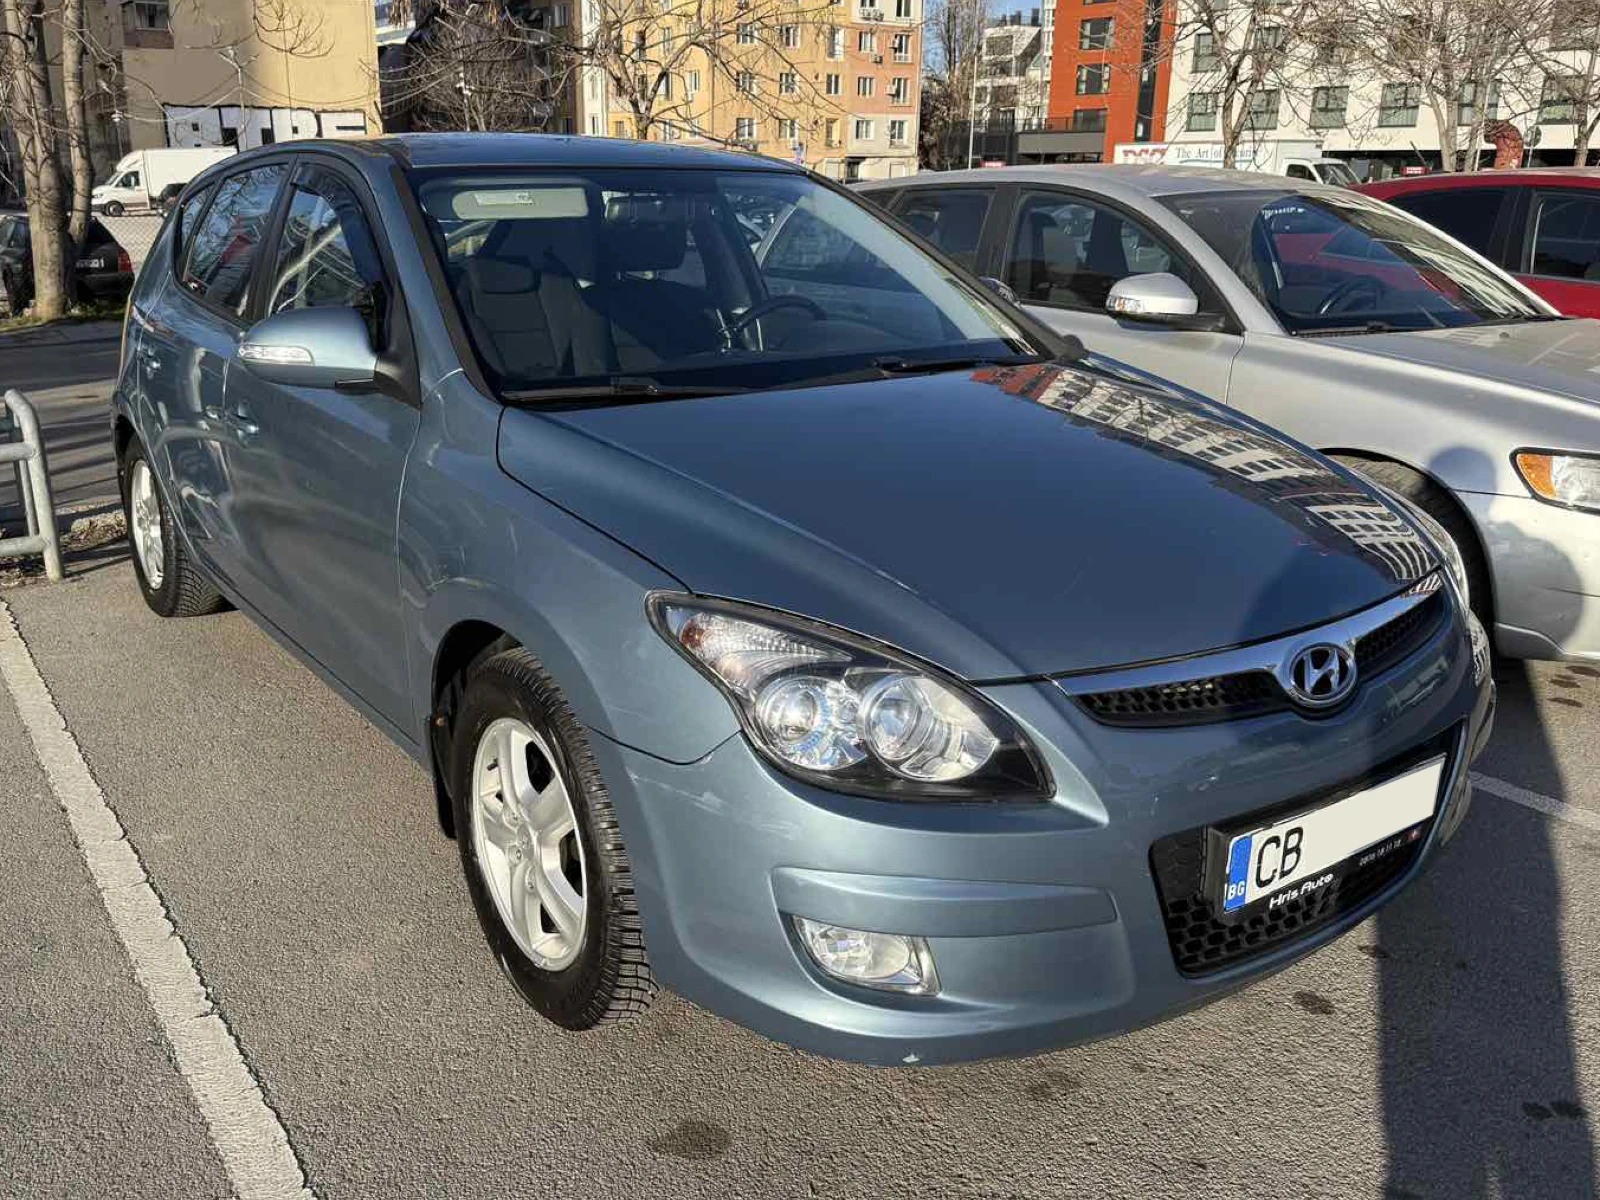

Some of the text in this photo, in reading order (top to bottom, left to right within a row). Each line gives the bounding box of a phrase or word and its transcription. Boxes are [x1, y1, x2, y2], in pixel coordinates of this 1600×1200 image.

[1175, 147, 1191, 159] The
[1195, 147, 1209, 159] Art
[1213, 147, 1222, 159] of
[1255, 826, 1304, 889] CB
[1228, 880, 1246, 900] BG
[1300, 873, 1334, 894] Auto
